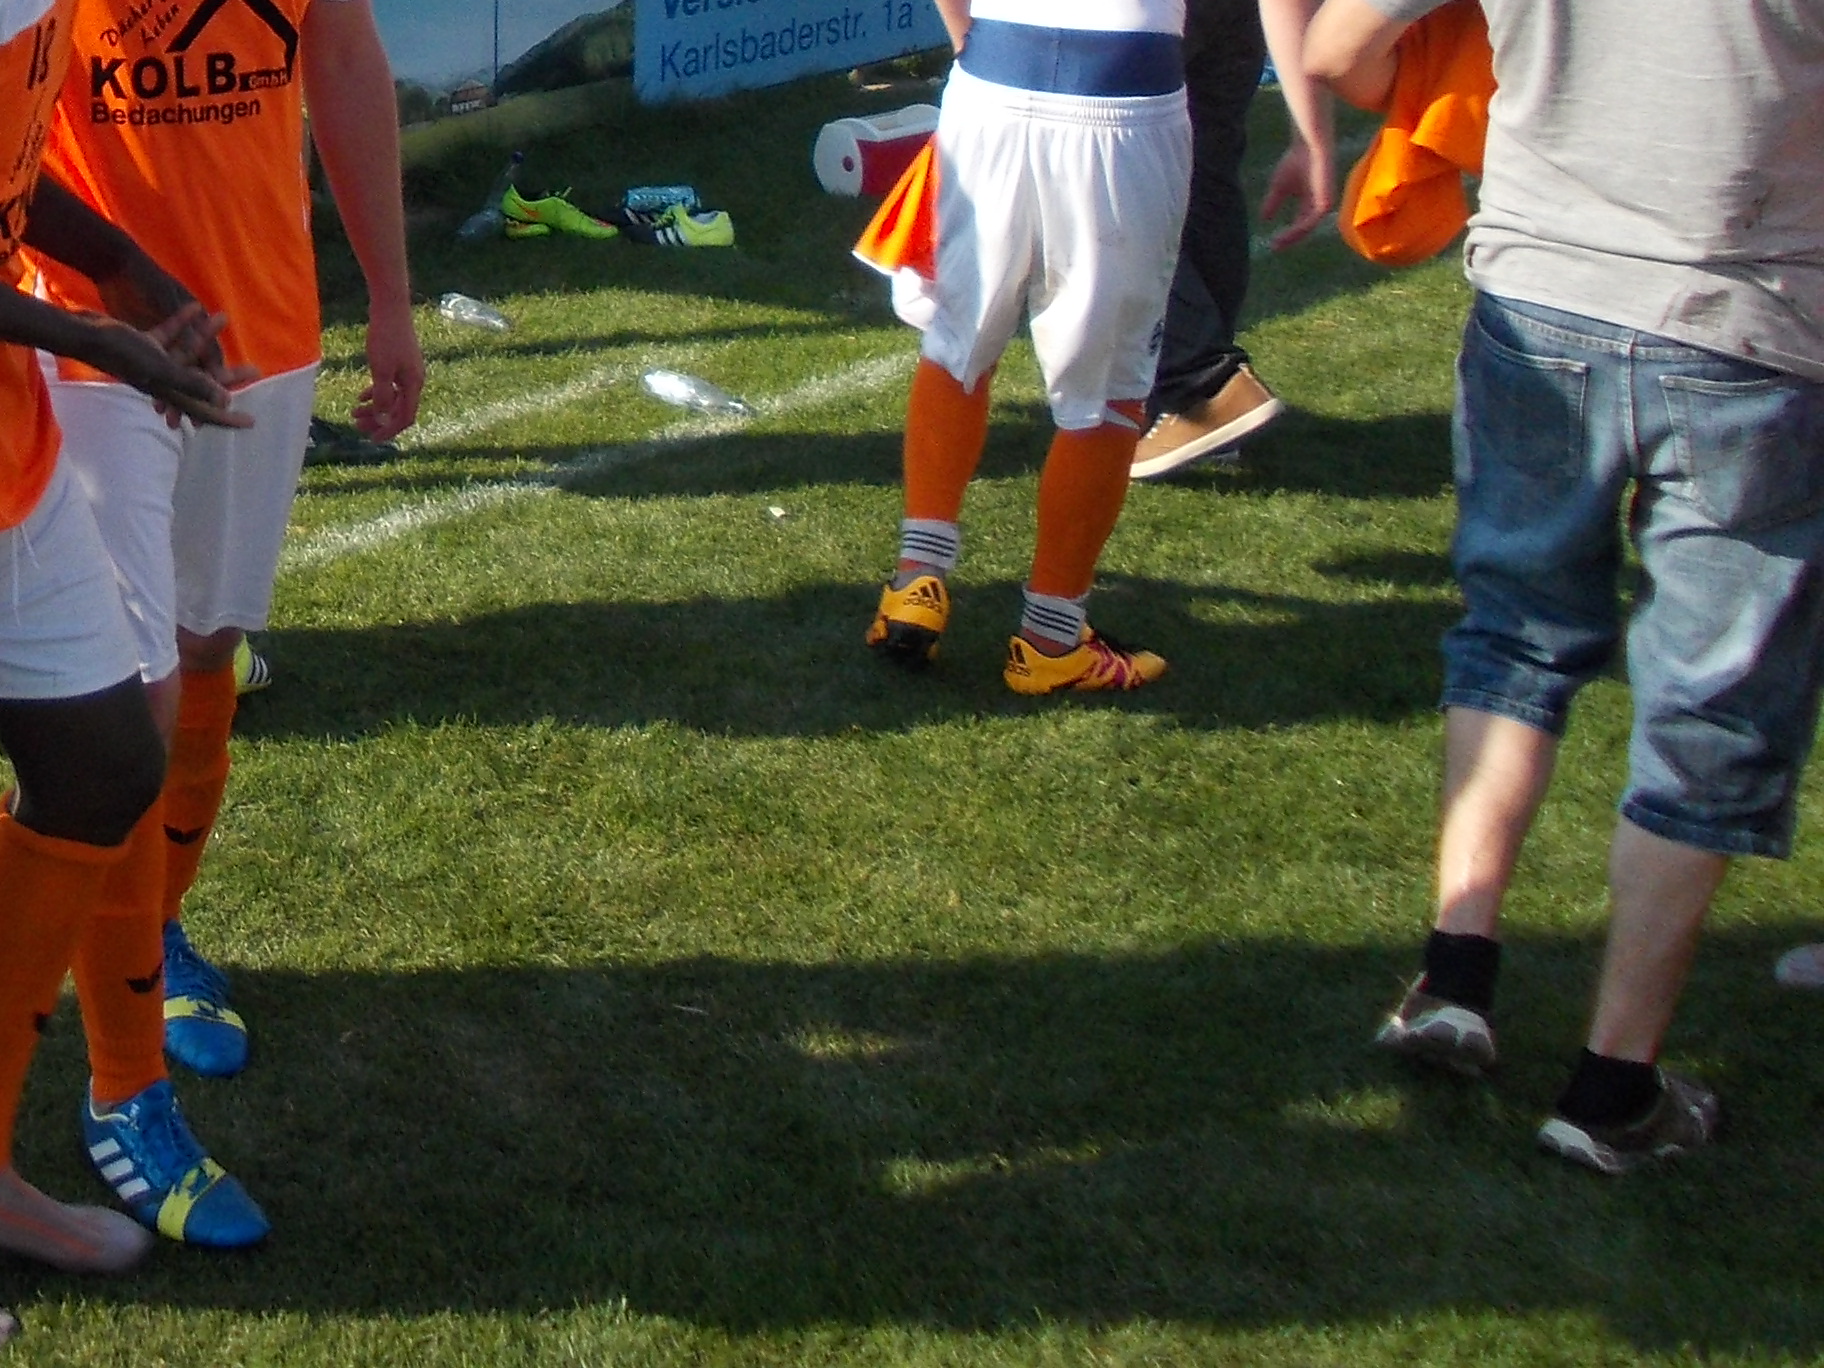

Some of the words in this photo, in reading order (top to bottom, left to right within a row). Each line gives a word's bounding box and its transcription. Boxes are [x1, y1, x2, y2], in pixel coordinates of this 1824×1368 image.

[660, 7, 867, 82] Karlsbaderstr.
[91, 52, 237, 99] KOLB
[91, 99, 261, 125] Bedachungen
